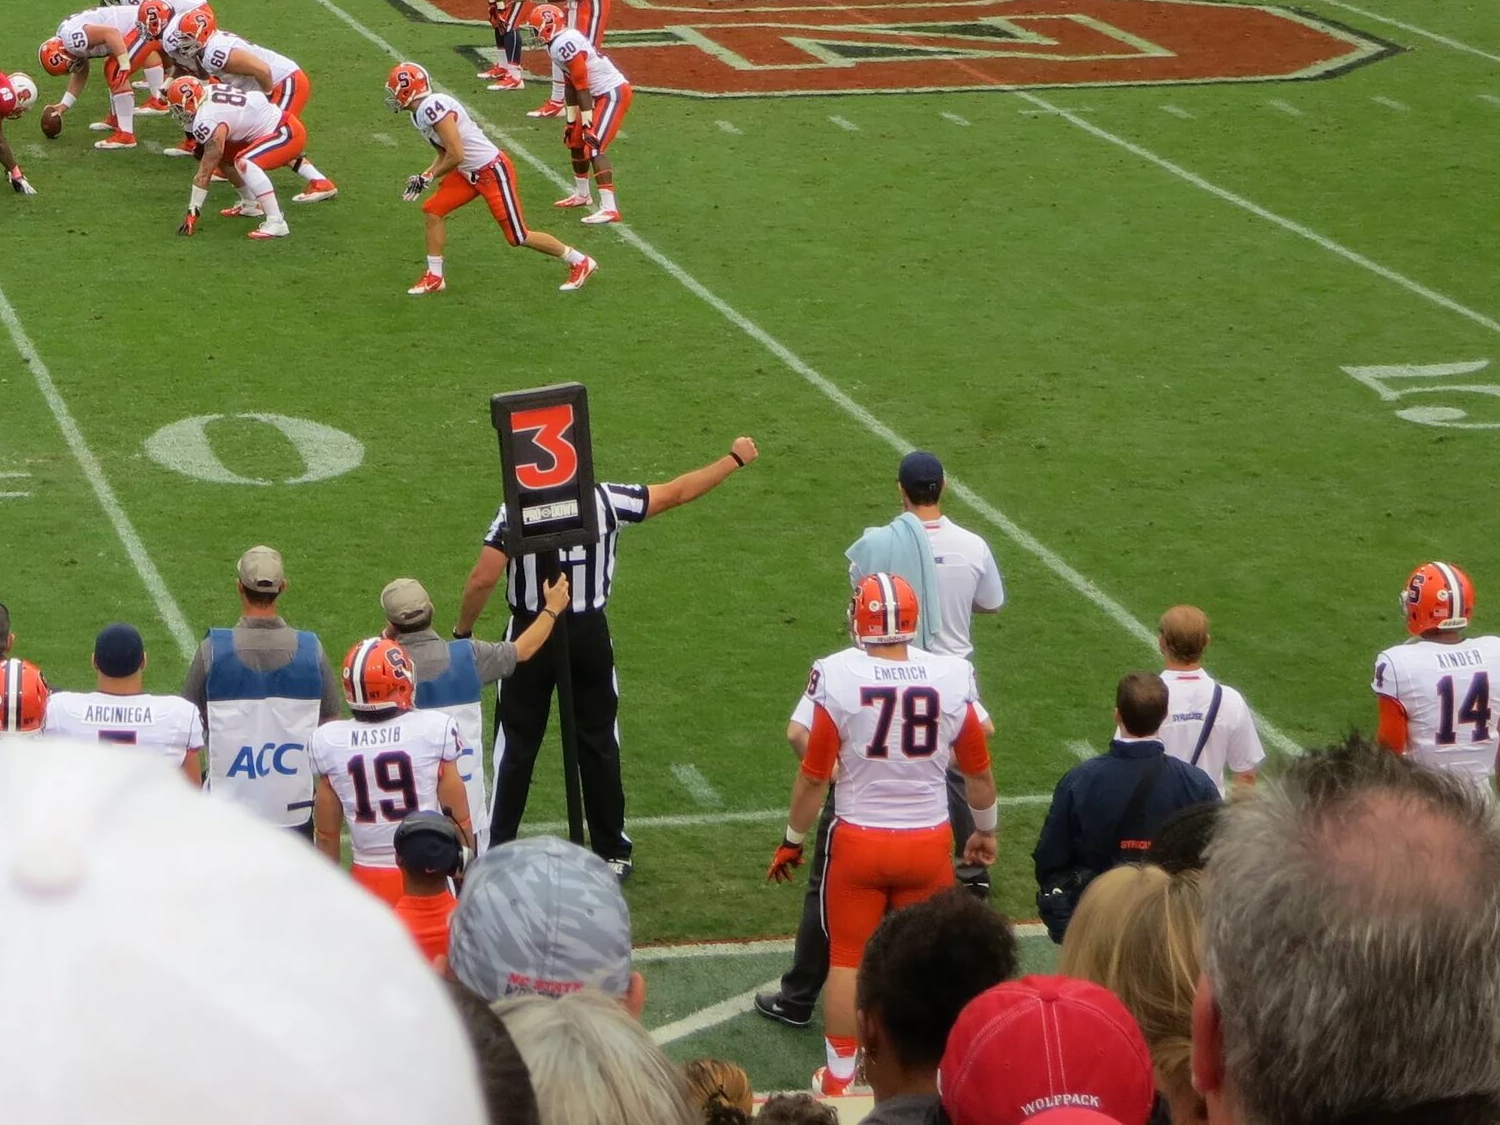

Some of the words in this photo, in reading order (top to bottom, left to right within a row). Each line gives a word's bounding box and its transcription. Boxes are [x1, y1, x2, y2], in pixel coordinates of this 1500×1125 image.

[210, 49, 227, 68] 60
[558, 40, 577, 59] 20
[424, 99, 446, 122] 84
[194, 122, 211, 142] 85
[510, 403, 579, 490] 3
[1437, 649, 1483, 669] KINDER
[874, 665, 928, 681] EMERICH
[85, 705, 153, 724] ARCINIEGA
[1435, 671, 1492, 745] 14
[860, 686, 941, 759] 78
[351, 726, 401, 747] NASSIB
[226, 742, 305, 780] ACC
[347, 750, 420, 824] 19
[1020, 1093, 1102, 1117] WOLFPACK
